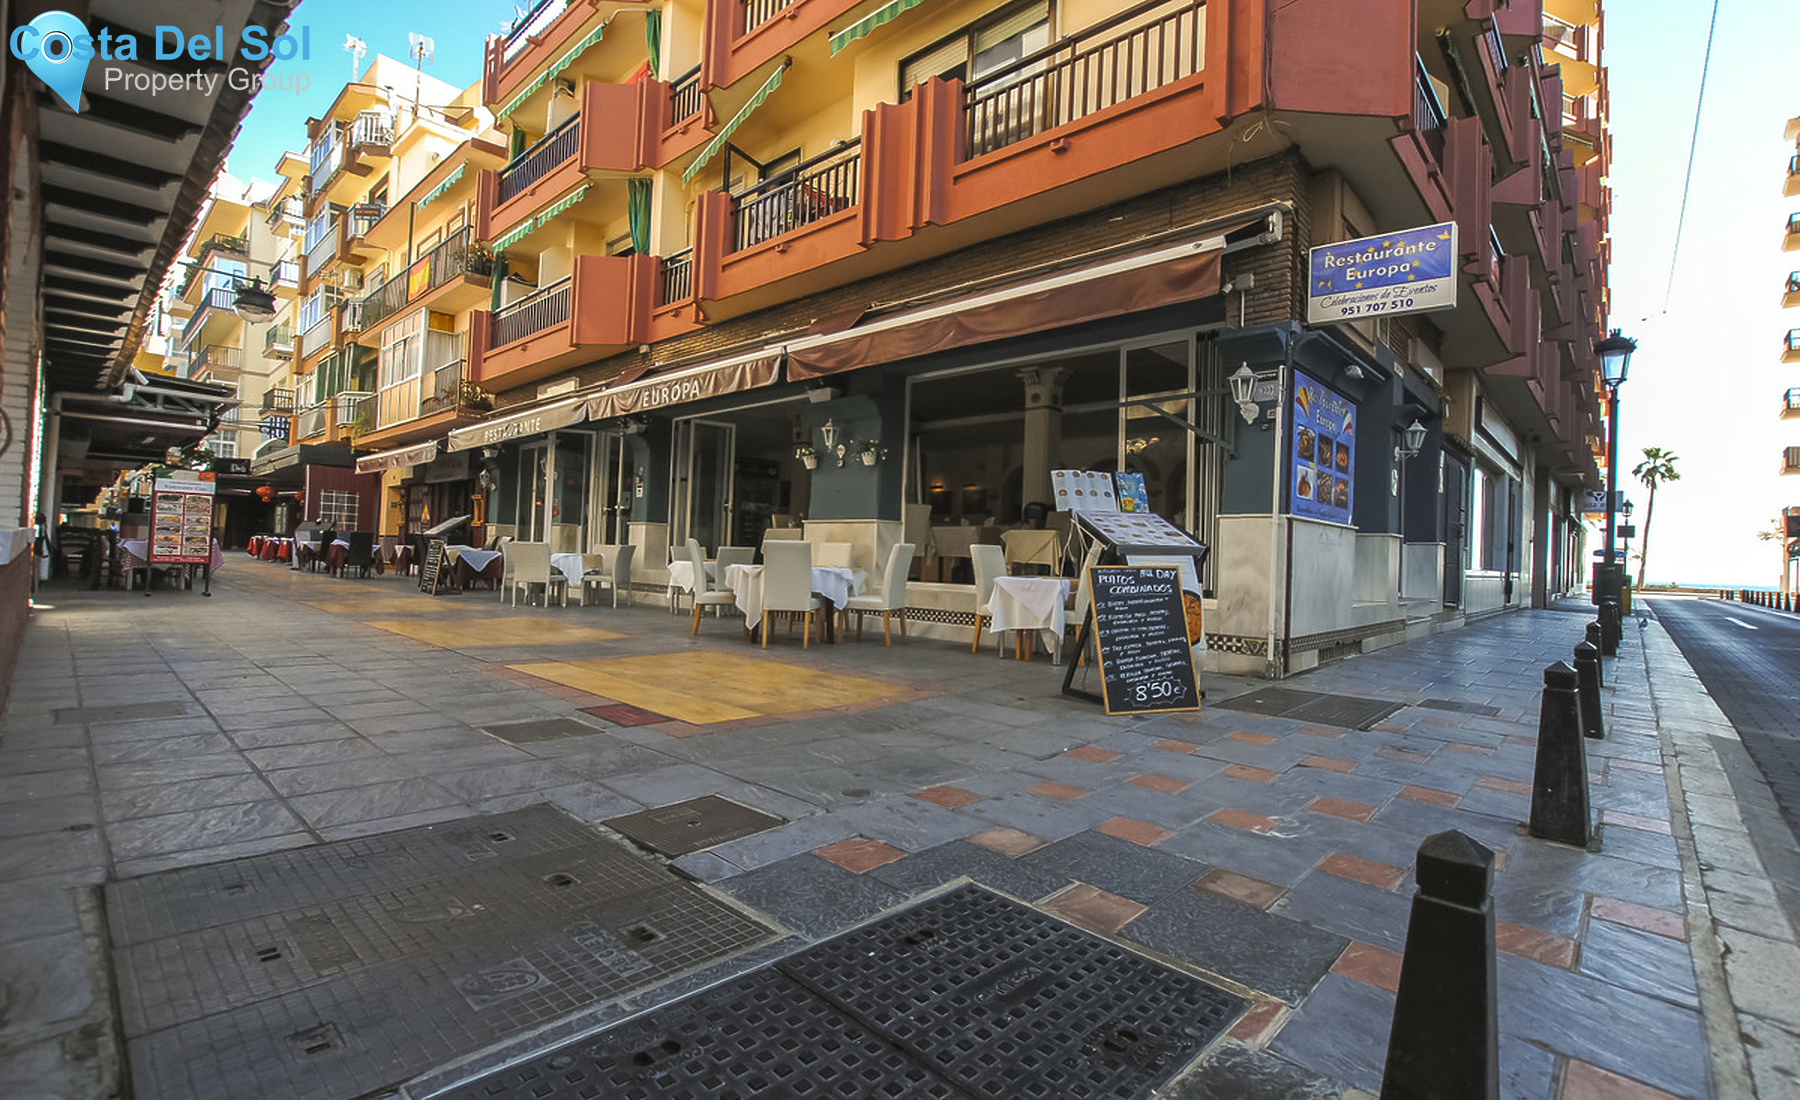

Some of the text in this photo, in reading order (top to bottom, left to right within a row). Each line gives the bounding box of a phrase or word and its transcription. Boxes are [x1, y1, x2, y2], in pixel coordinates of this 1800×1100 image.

[1324, 241, 1437, 268] Restaurante
[1345, 262, 1411, 281] Europa
[1320, 284, 1438, 309] Celebraciones de Eventos
[1341, 299, 1414, 316] 951 707 510
[642, 380, 700, 408] EUROPA
[484, 417, 541, 442] RESTAURANTE
[1098, 575, 1135, 585] PLATOS
[1156, 569, 1177, 580] DAY
[1109, 584, 1173, 594] COMBINADOS
